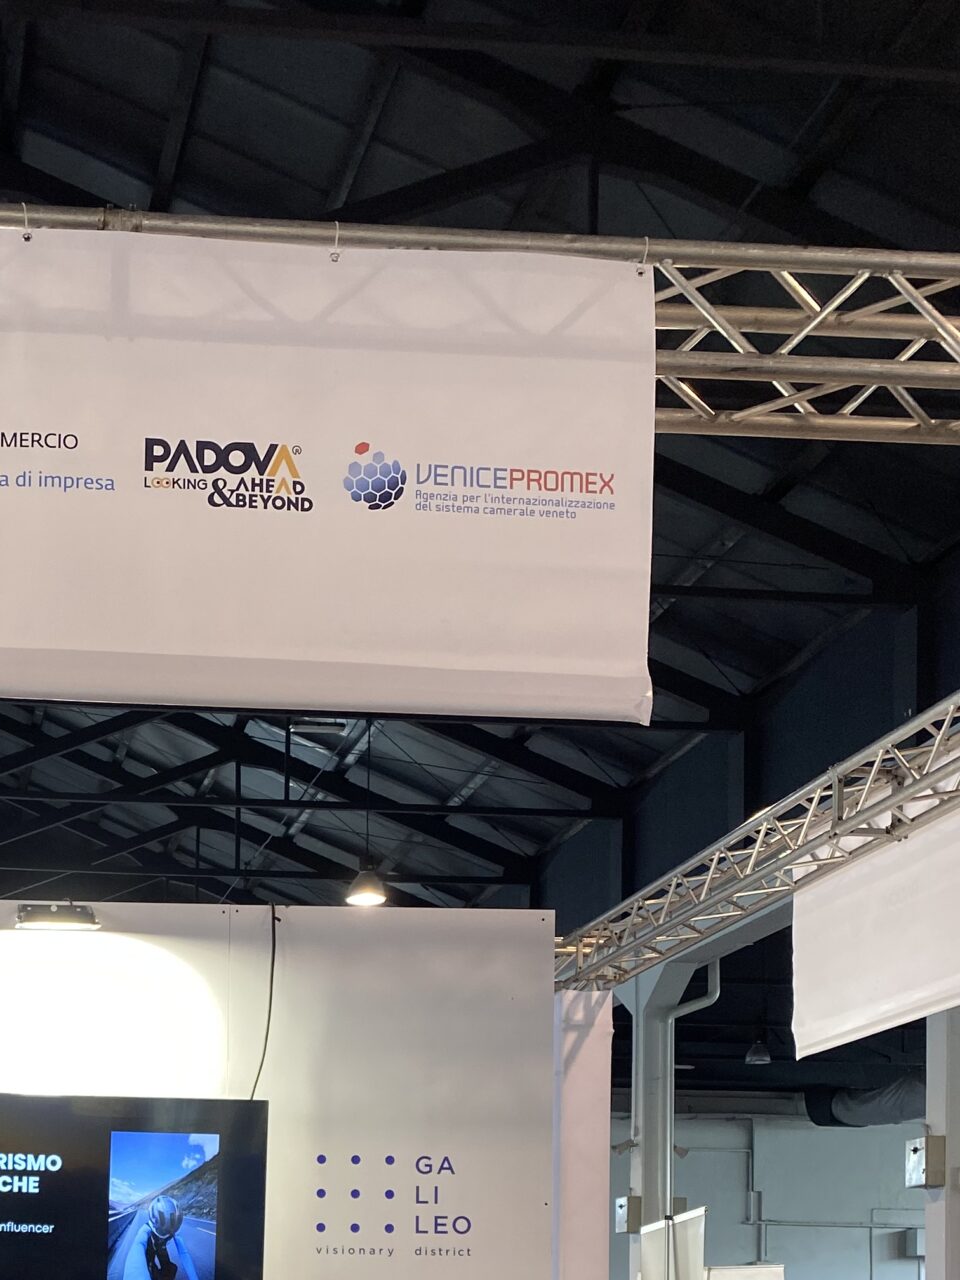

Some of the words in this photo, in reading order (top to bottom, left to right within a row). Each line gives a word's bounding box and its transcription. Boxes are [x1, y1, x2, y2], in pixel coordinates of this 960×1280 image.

[15, 470, 33, 488] di
[38, 472, 116, 494] impresa
[415, 463, 615, 495] VENICEPROMEX
[143, 476, 208, 491] LOOKING
[207, 478, 237, 508] &
[236, 478, 305, 496] AHEAD
[414, 490, 459, 505] Agenzia
[461, 493, 480, 507] per
[483, 494, 616, 511] l'internazionalizzazione
[235, 493, 314, 513] BEYOND
[414, 502, 433, 512] del
[434, 503, 480, 514] sistema
[482, 505, 536, 518] camerale
[538, 508, 577, 519] veneto
[415, 1156, 456, 1175] GA
[415, 1185, 439, 1205] LI
[415, 1215, 472, 1235] LEO
[315, 1245, 395, 1258] visionary
[414, 1246, 472, 1257] district
